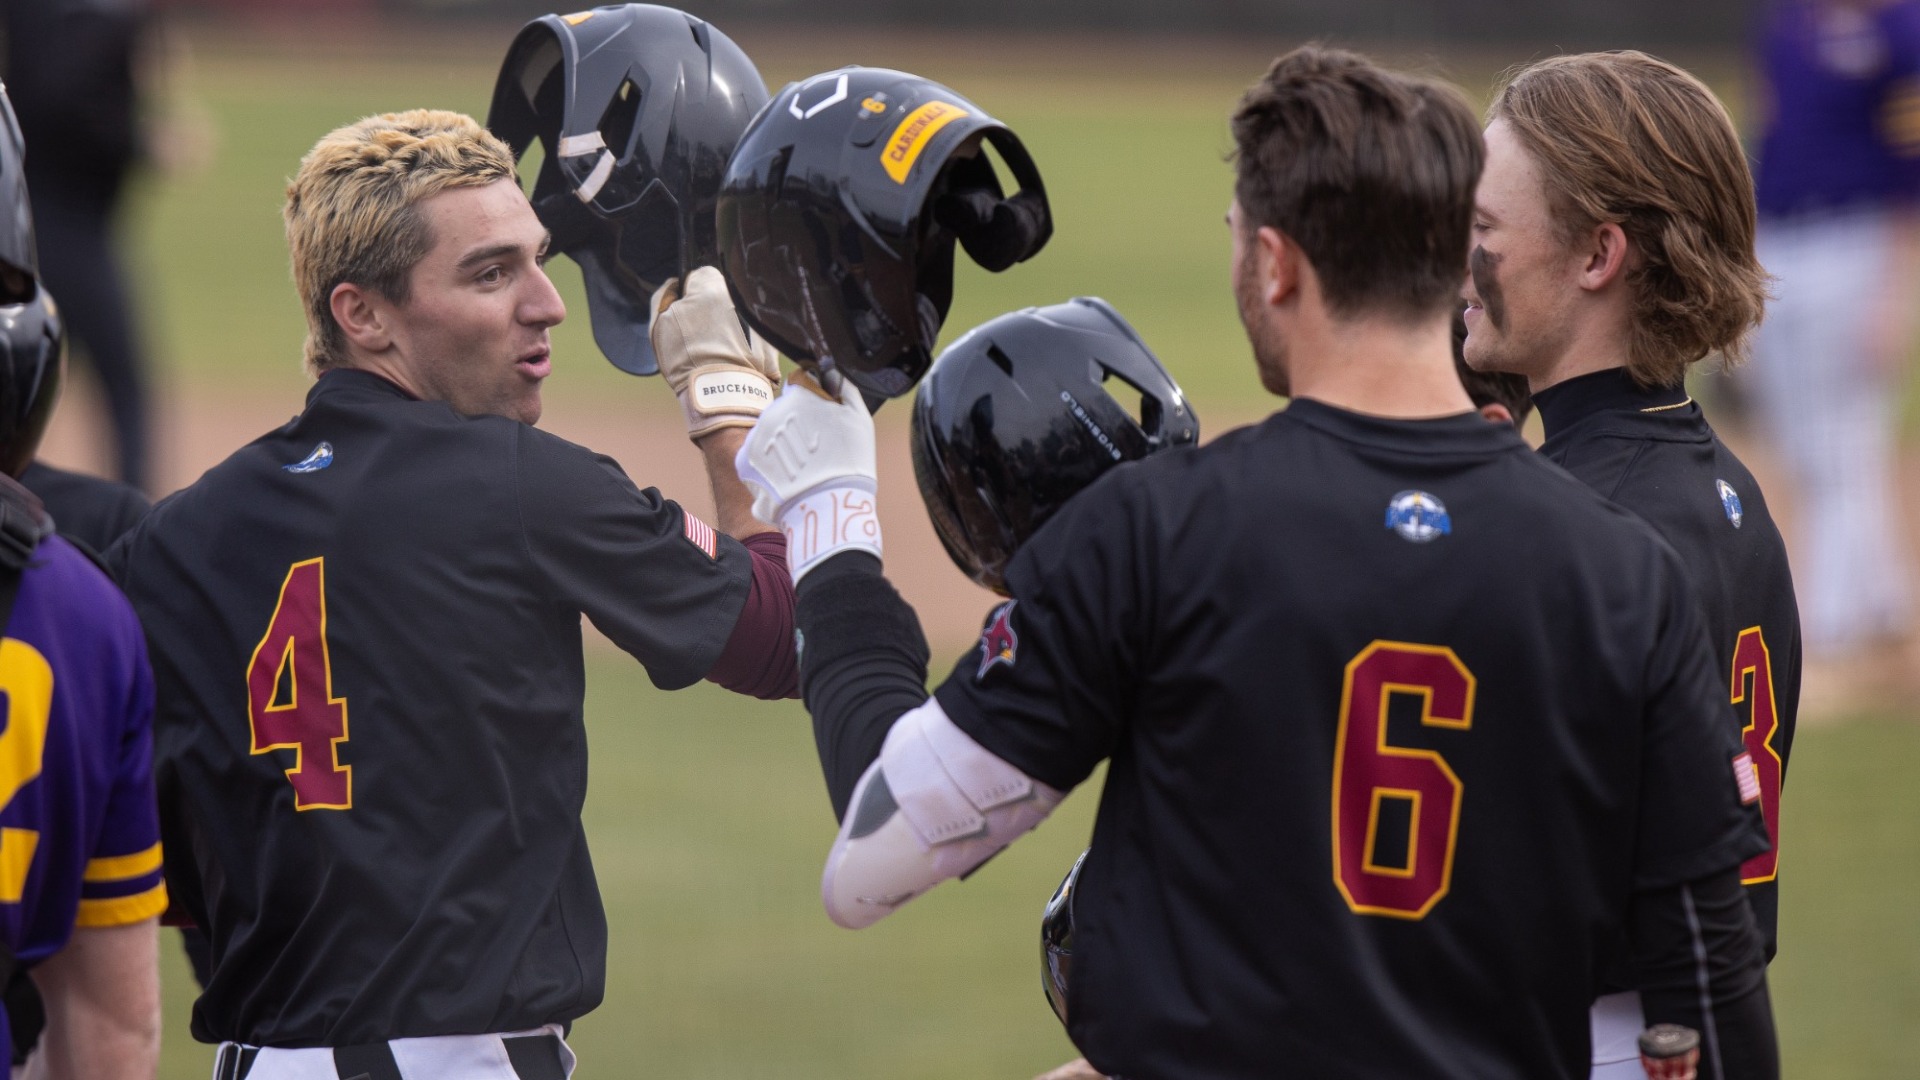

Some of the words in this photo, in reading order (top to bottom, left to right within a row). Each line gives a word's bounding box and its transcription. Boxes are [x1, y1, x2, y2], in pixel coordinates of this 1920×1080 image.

[861, 97, 886, 114] 6
[702, 384, 741, 396] BRUCE
[747, 385, 768, 400] BOLT
[1060, 391, 1121, 460] EVOSHIELD
[247, 557, 353, 811] 4
[1331, 639, 1477, 920] 6
